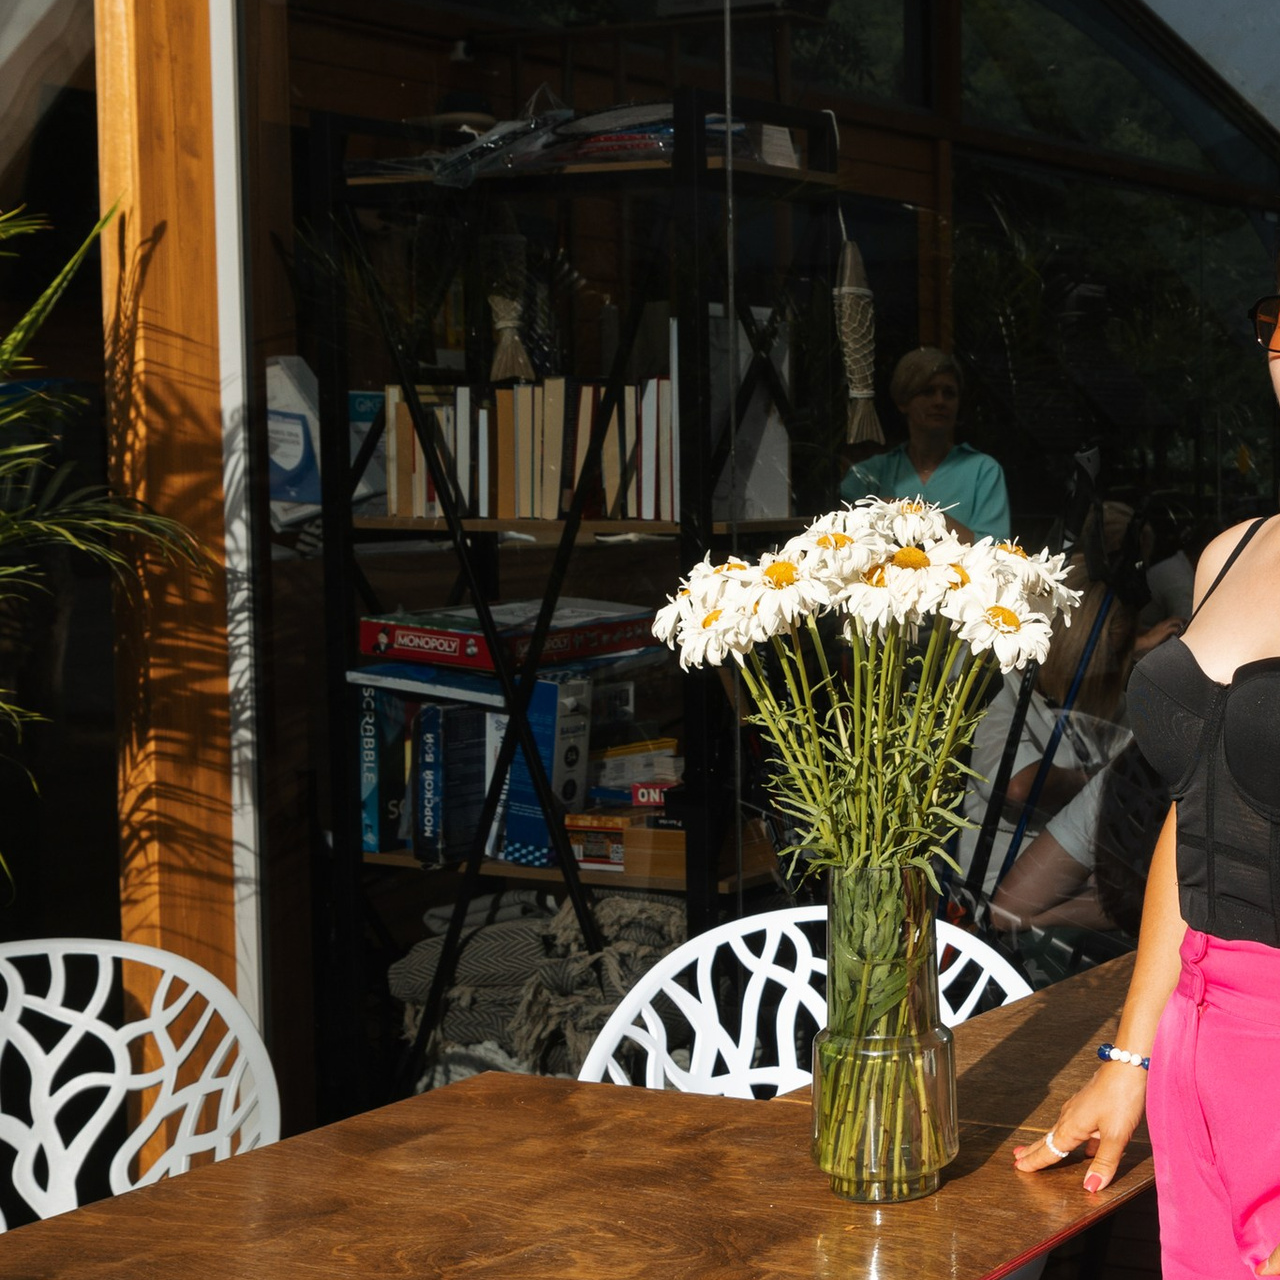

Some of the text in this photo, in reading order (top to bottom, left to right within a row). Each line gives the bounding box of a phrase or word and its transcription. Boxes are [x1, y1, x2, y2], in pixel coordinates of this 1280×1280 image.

[396, 634, 458, 654] MONOPOLY
[361, 687, 375, 783] SCRABBLE
[424, 770, 435, 838] МОРСКОЙ
